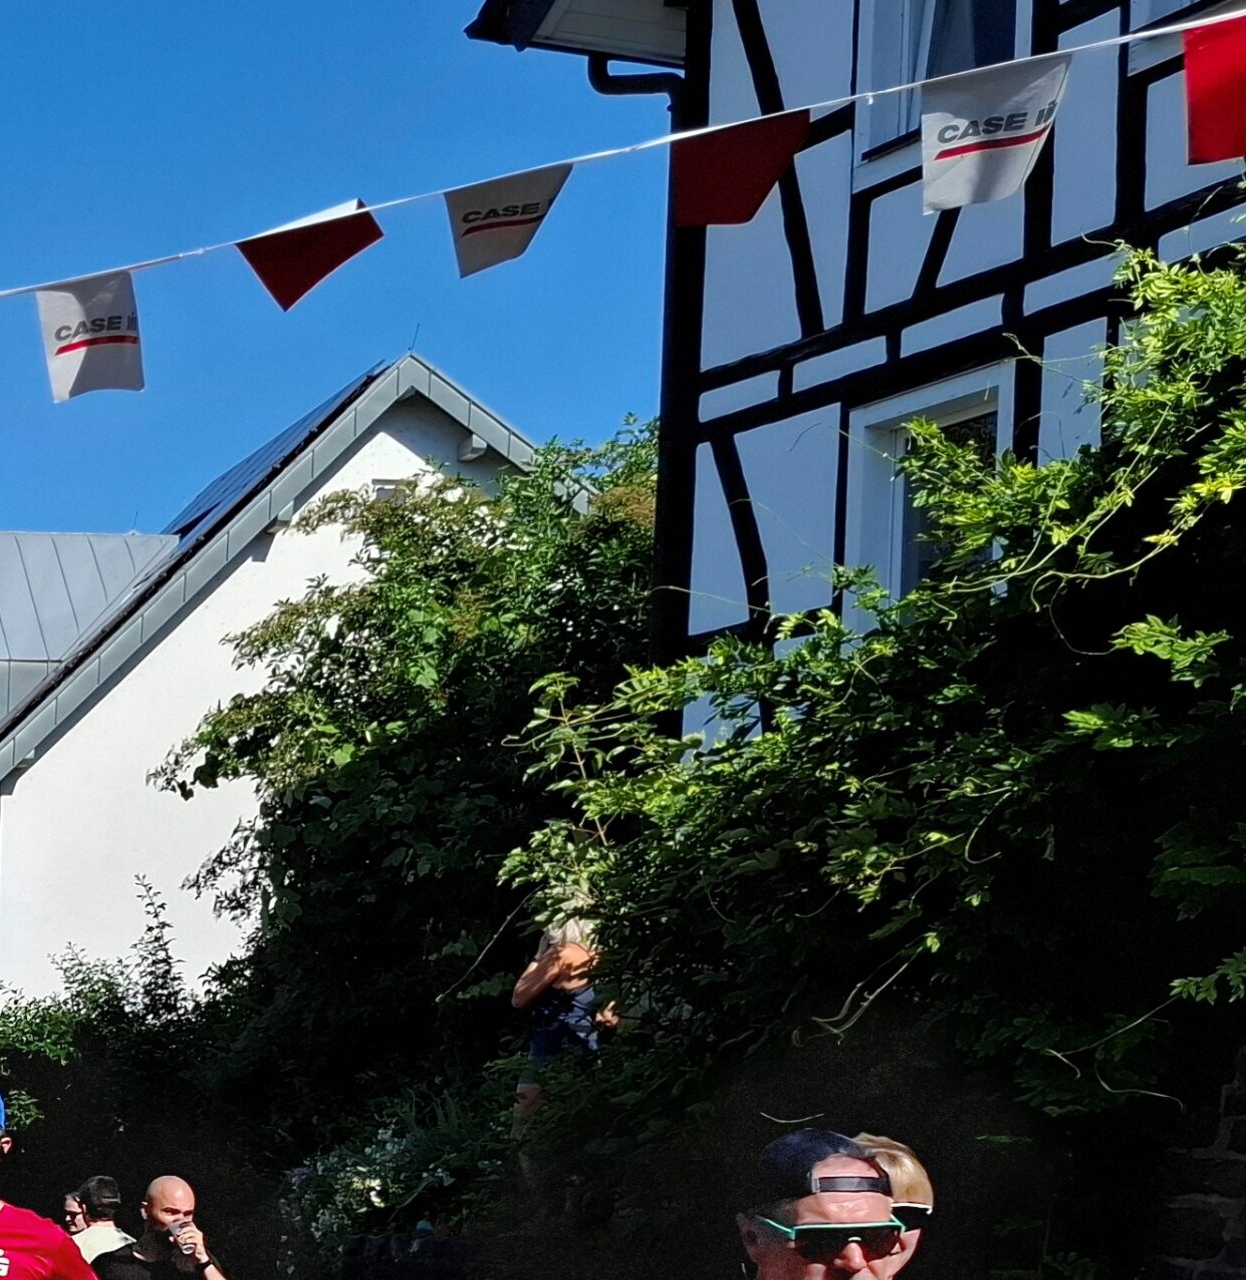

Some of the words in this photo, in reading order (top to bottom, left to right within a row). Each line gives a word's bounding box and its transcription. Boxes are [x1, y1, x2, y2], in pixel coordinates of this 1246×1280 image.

[937, 112, 1027, 144] CASE
[462, 202, 540, 223] CASE
[55, 315, 122, 341] CASE
